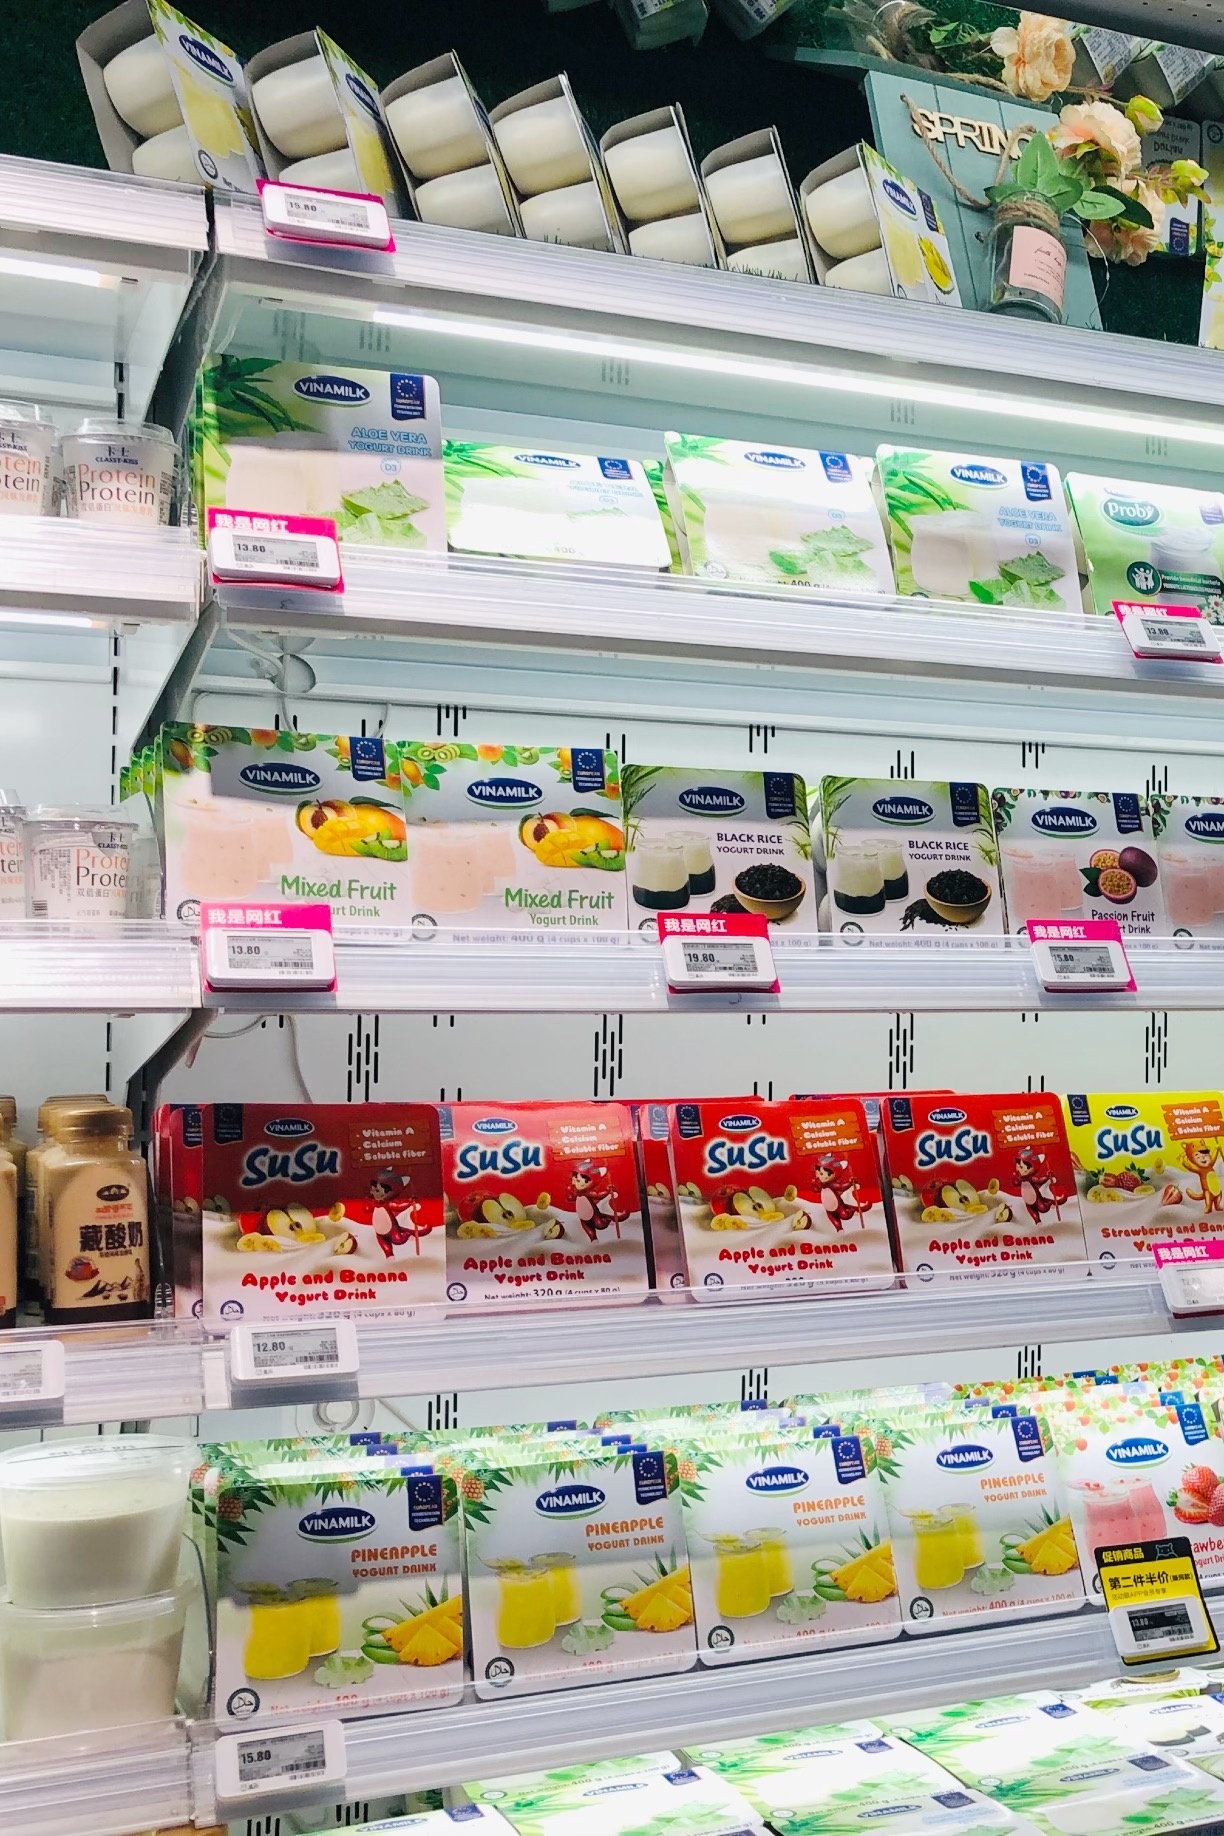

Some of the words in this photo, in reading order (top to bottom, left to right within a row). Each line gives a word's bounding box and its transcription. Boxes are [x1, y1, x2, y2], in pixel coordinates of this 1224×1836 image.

[184, 40, 231, 80] VINAMILK
[289, 201, 317, 212] 15.80
[299, 381, 366, 400] VINAMILK
[352, 428, 388, 440] ALOE
[391, 430, 427, 444] VERA
[349, 441, 392, 453] YOGURT
[395, 444, 431, 457] DRINK
[518, 455, 578, 468] VINAMILK
[749, 452, 803, 469] VINAMILK
[78, 464, 156, 488] Protein
[954, 467, 1004, 483] VINAMILK
[80, 481, 154, 505] Protein
[1108, 501, 1154, 521] Proby
[215, 515, 289, 533] 我是网红
[236, 543, 266, 554] 13.80
[245, 768, 316, 786] VINAMILK
[472, 783, 540, 799] VINAMILK
[683, 792, 742, 807] VINAMILK
[877, 802, 931, 816] VINAMILK
[1036, 814, 1094, 828] VINAMILK
[717, 832, 754, 844] BLACK
[756, 834, 783, 844] RICE
[908, 840, 942, 850] BLACK
[945, 841, 969, 851] RICE
[717, 846, 753, 855] YOGURT
[755, 847, 785, 856] DRINK
[909, 853, 942, 861] YOGURT
[945, 854, 971, 862] DRINK
[281, 875, 341, 898] Mixed
[347, 880, 397, 900] Fruit
[505, 887, 562, 909] Mixed
[567, 890, 614, 909] Fruit
[208, 909, 282, 925] 我是网红
[354, 905, 380, 917] Drink
[1092, 910, 1128, 921] Passion
[1131, 911, 1155, 922] Fruit
[530, 914, 566, 928] Yogurt
[569, 914, 599, 926] Drink
[664, 918, 727, 932] 我是网红
[1128, 923, 1151, 934] Drink
[1033, 926, 1085, 938] 我是网红
[231, 945, 260, 955] 13.80
[686, 952, 715, 963] 19.80
[269, 1123, 310, 1132] VINAMILK
[361, 1128, 402, 1138] Vitamin
[404, 1127, 414, 1136] A
[362, 1139, 402, 1149] Calcium
[918, 1131, 989, 1164] SuSu
[1098, 1126, 1162, 1159] SuSu
[363, 1152, 400, 1162] Soluble
[458, 1142, 541, 1178] SuSu
[708, 1137, 787, 1172] SuSu
[242, 1145, 339, 1186] SuSu
[80, 1221, 143, 1252] 藏酸奶
[1101, 1226, 1174, 1239] Strawberry
[1177, 1224, 1198, 1234] and
[929, 1239, 971, 1253] Apple
[975, 1238, 998, 1248] and
[1003, 1234, 1055, 1246] Banana
[719, 1247, 765, 1263] Apple
[769, 1246, 795, 1258] and
[799, 1242, 858, 1255] Banana
[463, 1256, 513, 1273] Apple
[518, 1255, 546, 1268] and
[551, 1252, 612, 1266] Banana
[241, 1272, 297, 1291] Apple
[301, 1273, 333, 1284] and
[339, 1270, 407, 1283] Banana
[275, 1290, 330, 1306] Yogurt
[334, 1288, 377, 1301] Drink
[255, 1341, 285, 1352] 12.80
[939, 1450, 992, 1467] VINAMILK
[1109, 1443, 1167, 1459] VINAMILK
[749, 1473, 807, 1488] VINAMILK
[980, 1473, 1045, 1490] PINEAPPLE
[539, 1492, 602, 1508] VINAMILK
[793, 1495, 865, 1513] PINEAPPLE
[303, 1514, 372, 1532] VINAMILK
[585, 1516, 665, 1536] PINEAPPLE
[351, 1544, 438, 1562] PINEAPPLE
[1103, 1548, 1144, 1563] 促销商品
[352, 1566, 399, 1577] YOGURT
[402, 1563, 437, 1575] DRINK
[1109, 1571, 1169, 1590] 第二件半价
[241, 1750, 271, 1763] 15.80
[1062, 1769, 1119, 1782] VINAMILK
